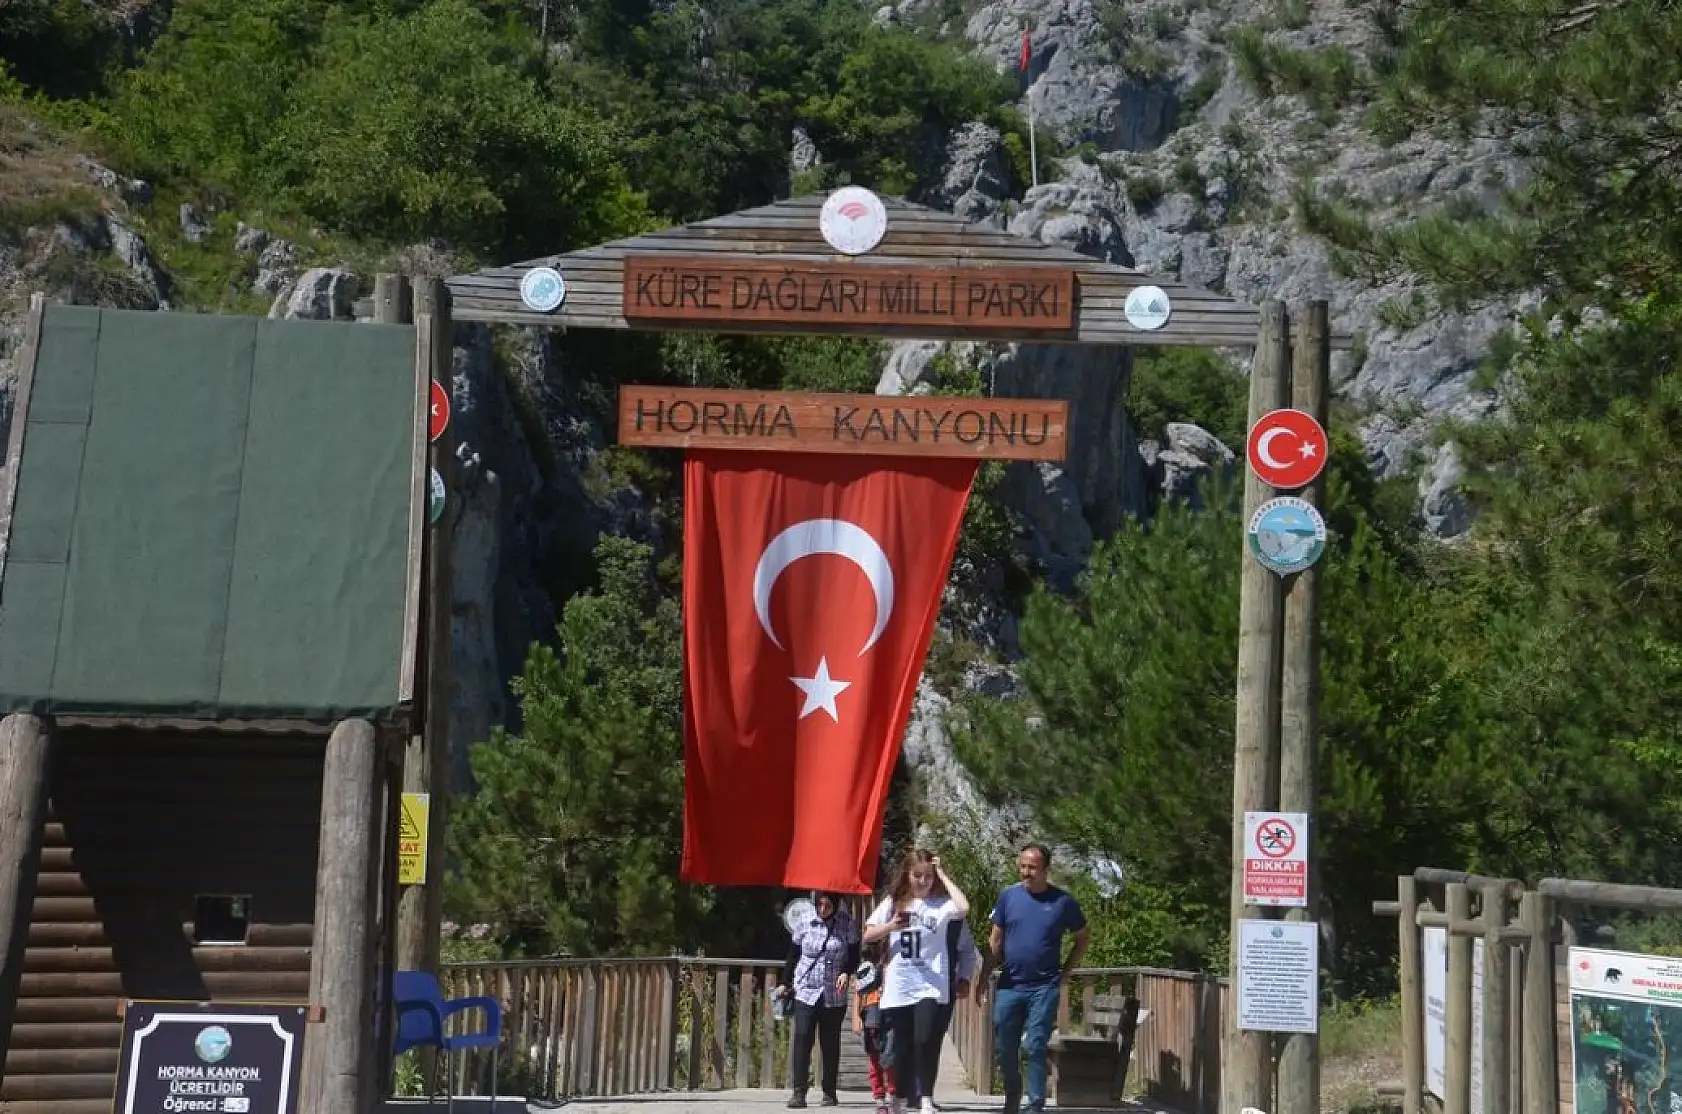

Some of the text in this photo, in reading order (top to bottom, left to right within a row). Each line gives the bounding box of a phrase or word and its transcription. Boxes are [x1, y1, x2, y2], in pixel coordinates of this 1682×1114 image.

[636, 267, 1058, 318] KÜRE DAĞLARI MİLLİ PARKI
[635, 398, 1050, 446] HORMA KANYONU
[900, 931, 922, 959] 91
[158, 1066, 259, 1079] HORMA KANYON
[169, 1080, 245, 1095] ÜCRETLİDİR
[163, 1096, 217, 1112] Öğrenci
